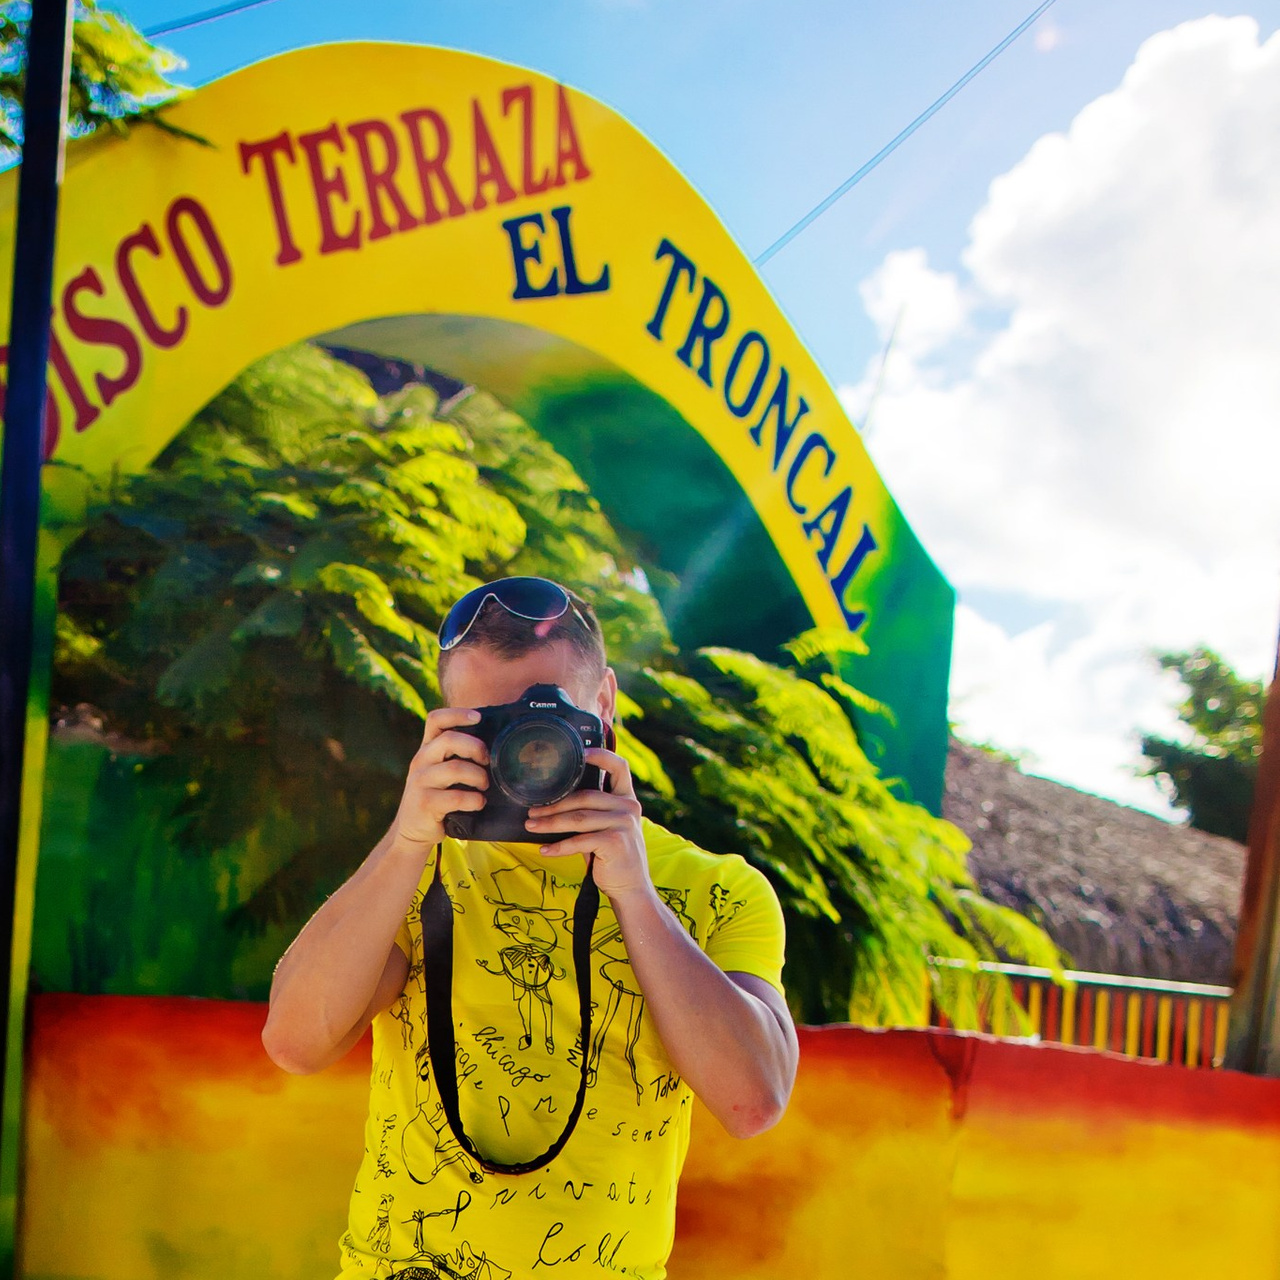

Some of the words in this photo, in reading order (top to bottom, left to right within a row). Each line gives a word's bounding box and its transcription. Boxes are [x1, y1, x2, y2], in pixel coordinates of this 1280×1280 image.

[238, 84, 592, 267] TERRAZA
[502, 205, 610, 299] EL
[646, 238, 878, 631] TRONCAL
[529, 701, 558, 709] Canon
